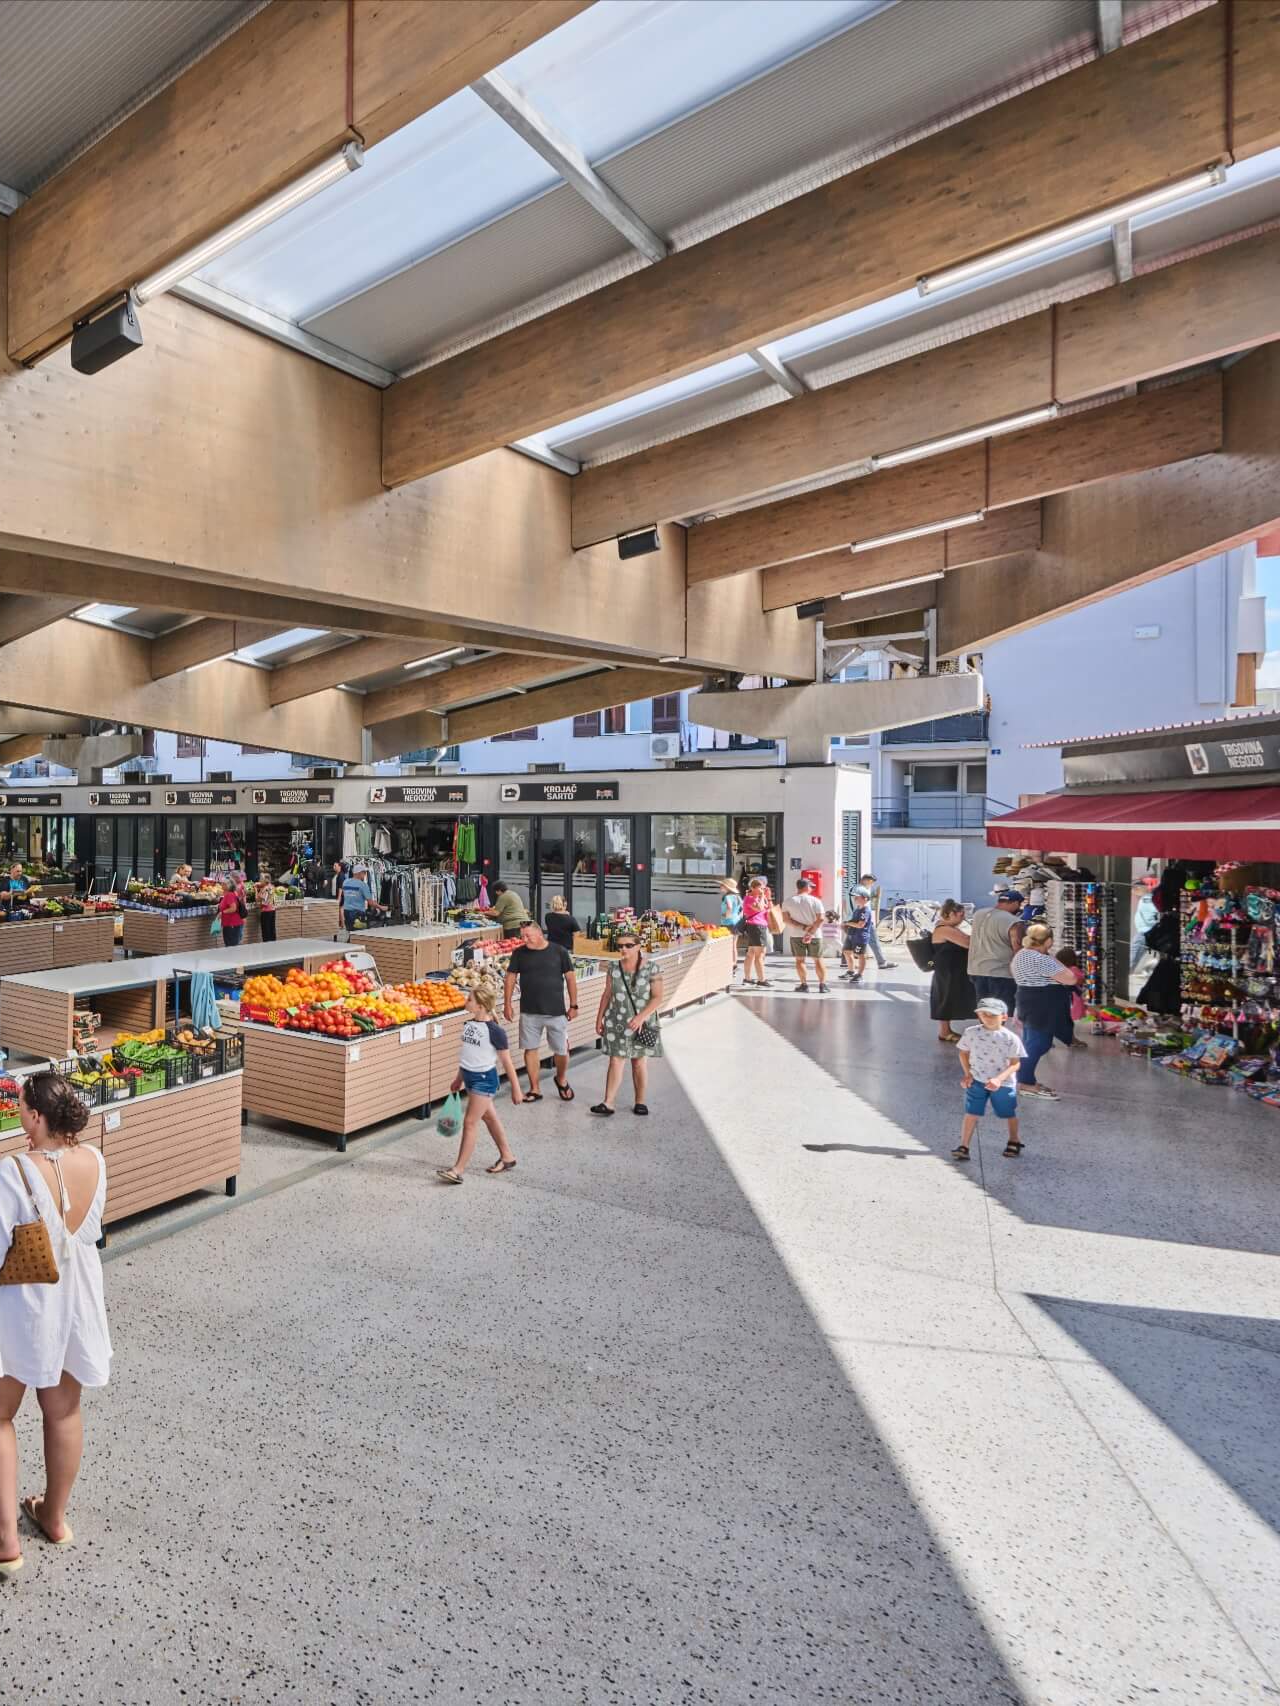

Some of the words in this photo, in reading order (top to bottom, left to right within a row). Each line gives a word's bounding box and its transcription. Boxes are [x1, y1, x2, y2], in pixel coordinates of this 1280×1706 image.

[402, 787, 437, 795] TRGOVINA
[543, 783, 577, 793] KROJAČ
[280, 789, 308, 797] TRGOVINA
[546, 792, 574, 800] SARTO
[404, 794, 435, 802] NEGOZIO
